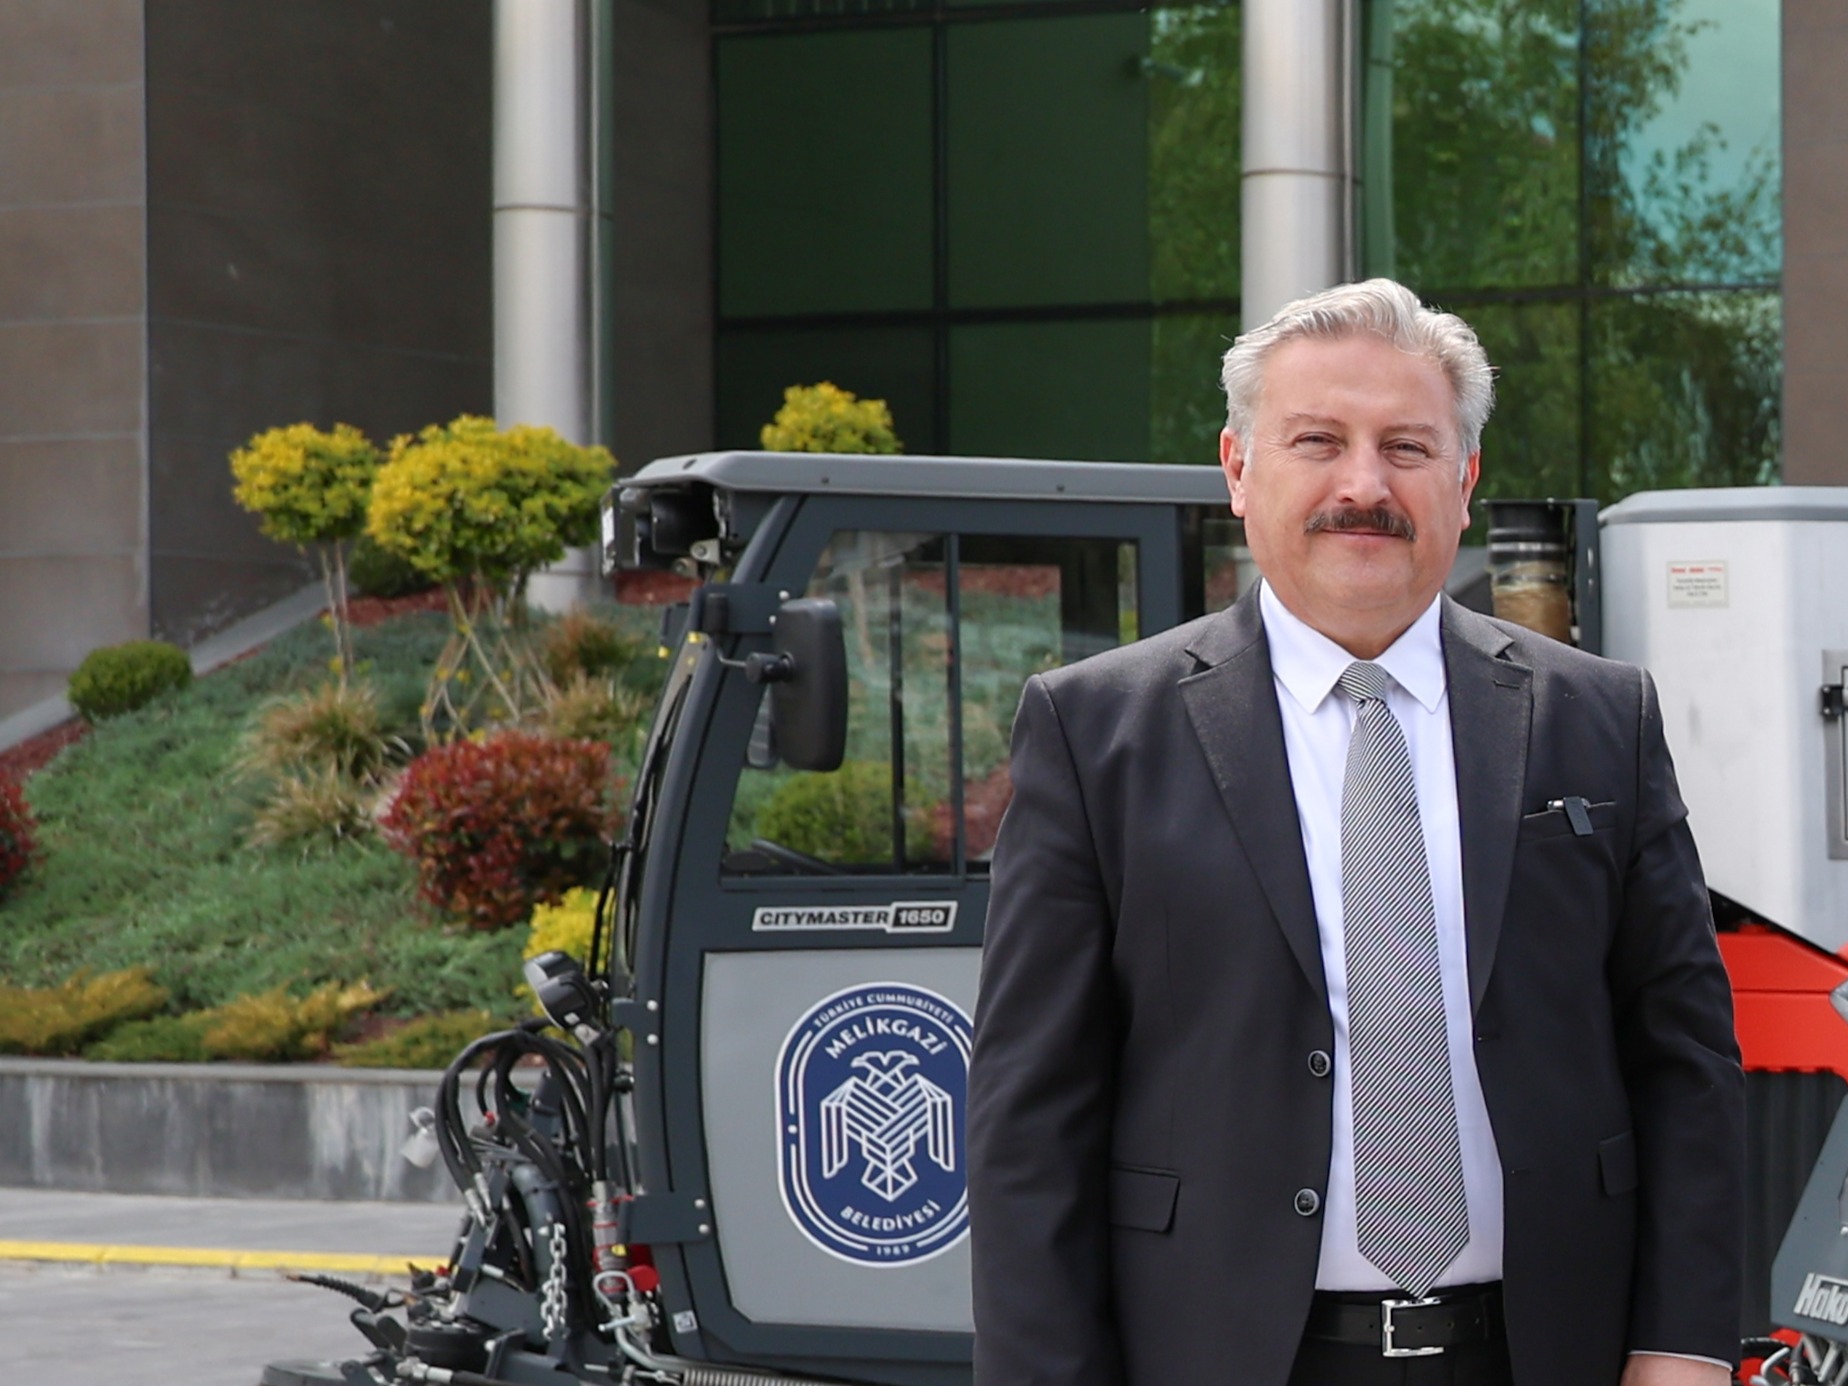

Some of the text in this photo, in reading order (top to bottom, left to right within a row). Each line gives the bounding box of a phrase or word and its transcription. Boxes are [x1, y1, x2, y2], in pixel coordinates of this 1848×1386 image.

[760, 909, 945, 926] CITYMASTER 1650
[813, 993, 955, 1028] TÜRKİYE CUMHURİYETİ
[825, 1016, 948, 1060] MELİKGAZİ
[840, 1199, 941, 1231] BELEDİYESİ
[876, 1244, 911, 1256] 1989
